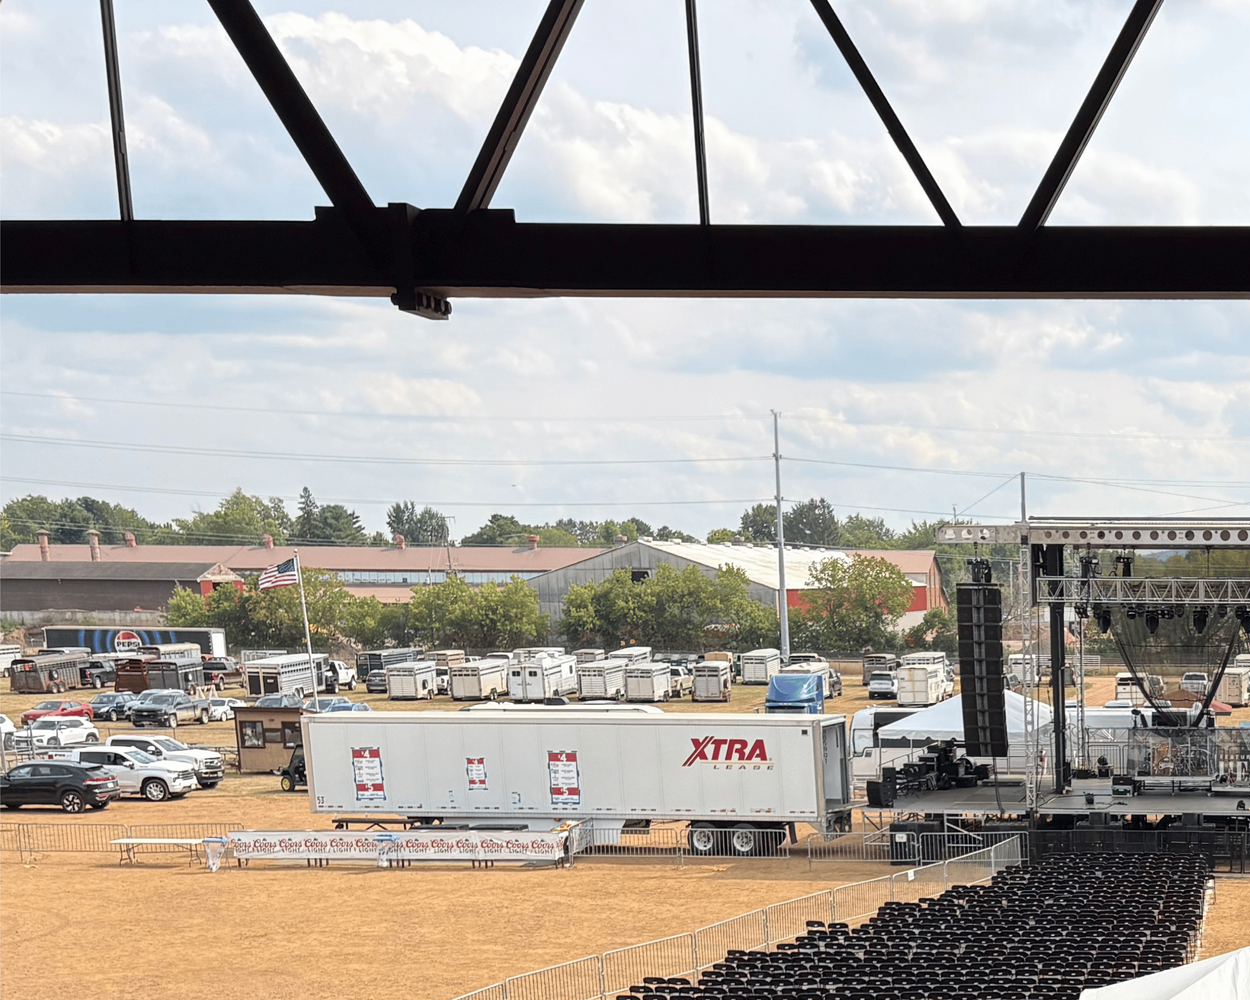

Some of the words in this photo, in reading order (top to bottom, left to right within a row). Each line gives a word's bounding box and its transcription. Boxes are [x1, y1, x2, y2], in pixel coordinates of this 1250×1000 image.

[682, 736, 768, 767] XTRA
[253, 839, 276, 848] Coors
[278, 839, 302, 848] Coors
[304, 839, 328, 848] Coors
[330, 839, 354, 848] Coors
[405, 839, 429, 849] Coors
[430, 839, 454, 849] Coors
[456, 839, 478, 849] Coors
[480, 839, 504, 849] Coors
[505, 839, 529, 849] Coors
[531, 840, 555, 850] Coors
